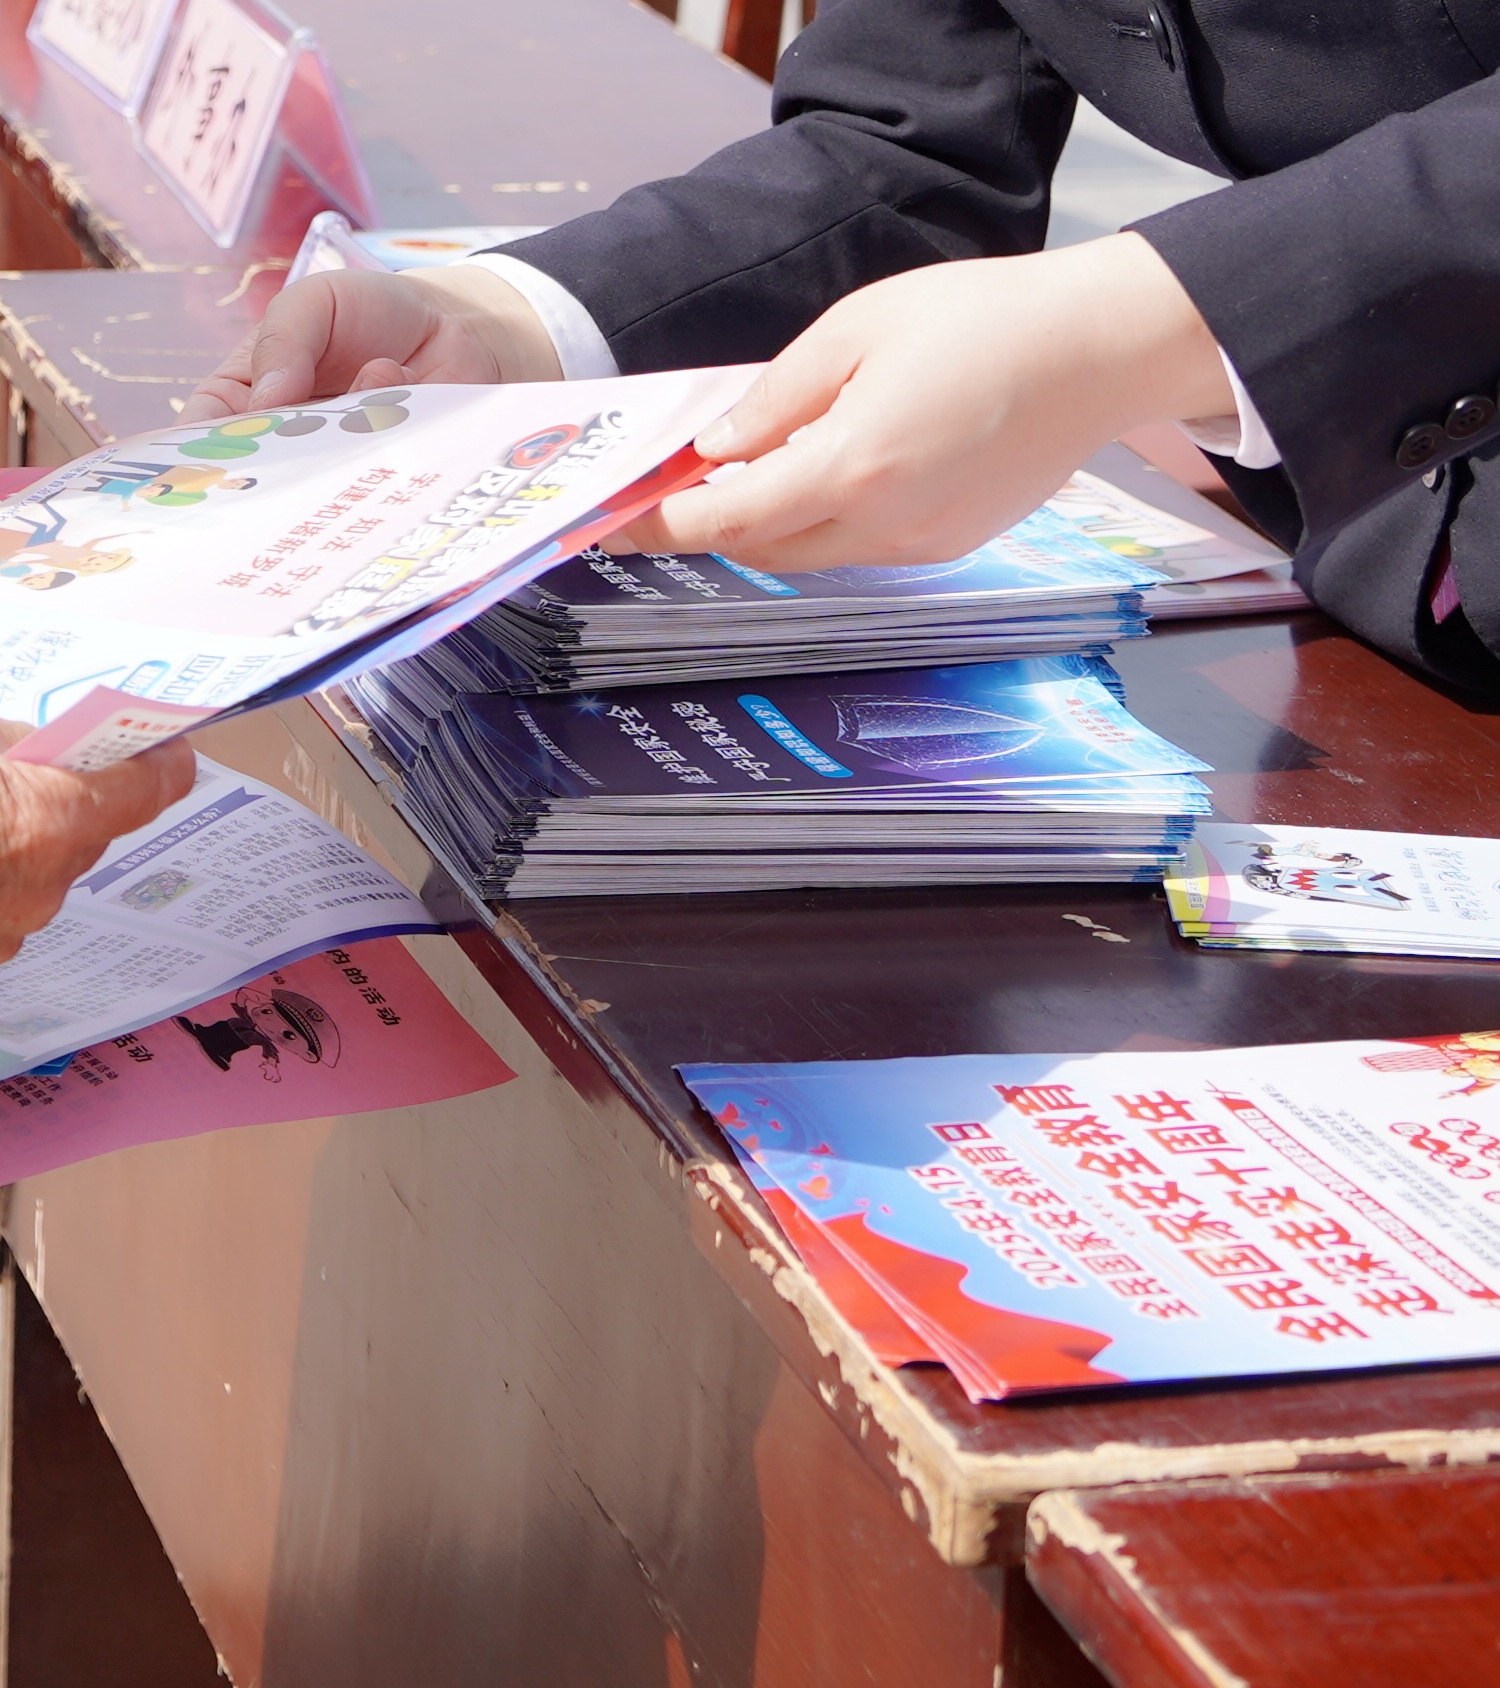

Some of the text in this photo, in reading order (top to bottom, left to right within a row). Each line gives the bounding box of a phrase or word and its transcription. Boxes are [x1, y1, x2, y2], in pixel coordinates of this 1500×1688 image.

[212, 467, 405, 588] 构建和谐新罗城
[253, 472, 447, 598] 学法 知法 守法
[580, 704, 733, 784] 维护国家安全
[650, 700, 802, 782] 严守国家秘密
[69, 1059, 104, 1087] 府组织
[902, 1163, 1081, 1287] 2025年4.15
[925, 1120, 1200, 1320] 全民国家安全教育日
[984, 1081, 1373, 1345] 全民国家安全教育
[1097, 1088, 1456, 1320] 走深走实十周年
